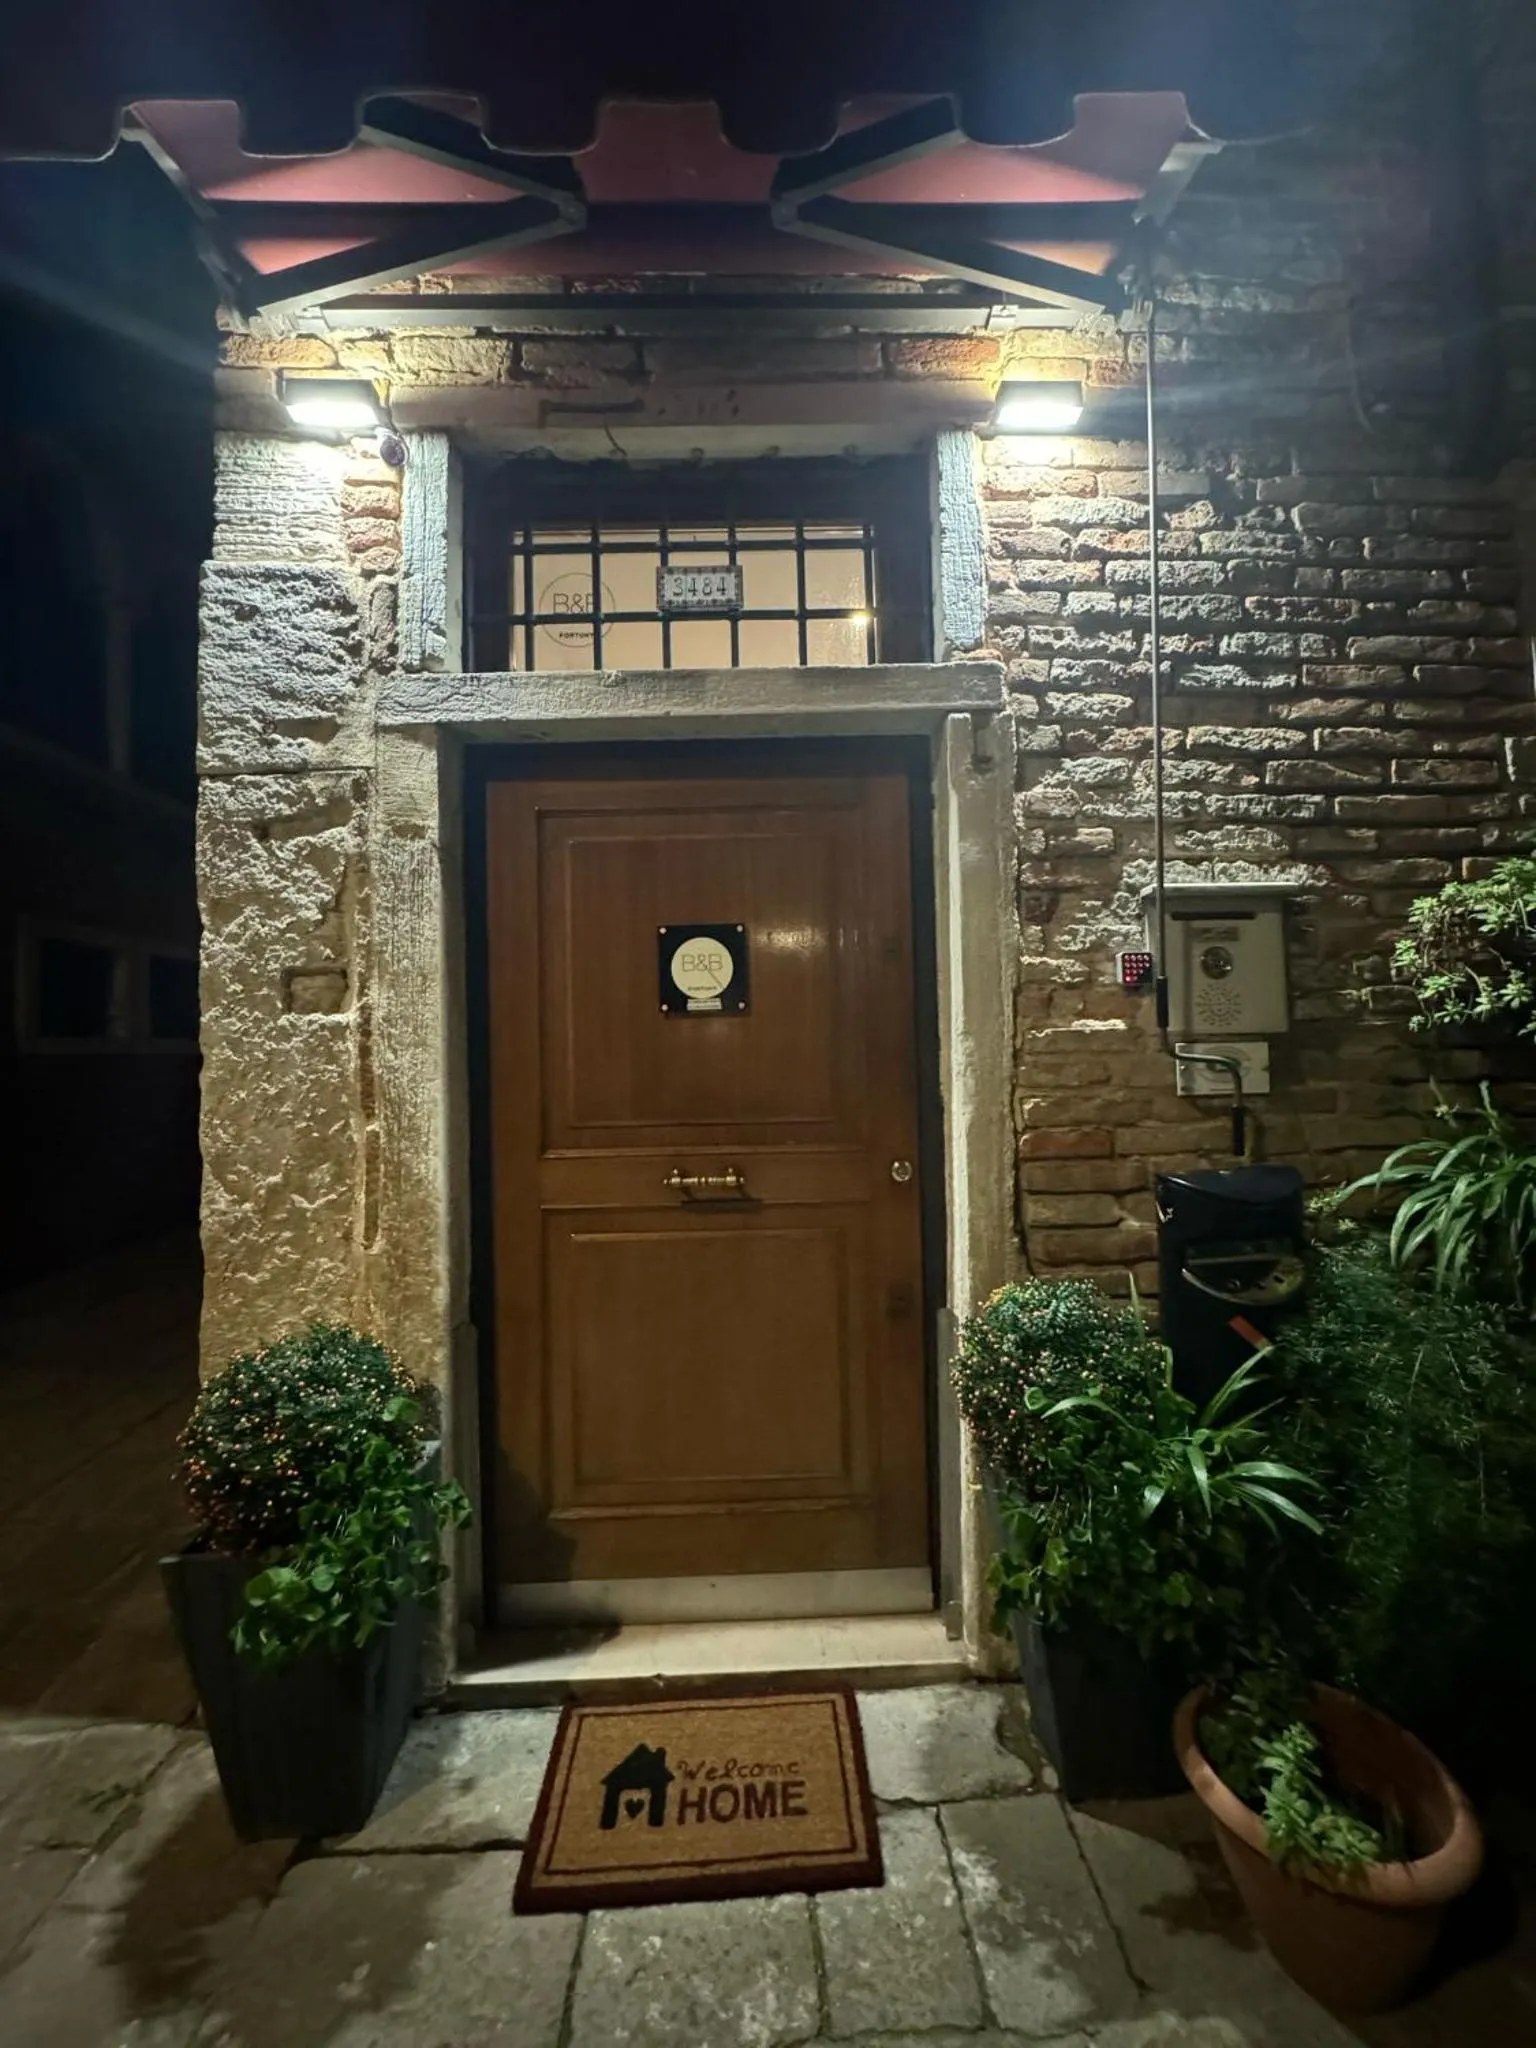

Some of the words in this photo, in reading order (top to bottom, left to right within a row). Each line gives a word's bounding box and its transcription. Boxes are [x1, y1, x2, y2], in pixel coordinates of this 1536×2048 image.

[672, 576, 727, 597] 3484
[682, 954, 723, 973] B&B
[676, 1758, 799, 1781] Welcome
[677, 1780, 808, 1826] HOME
